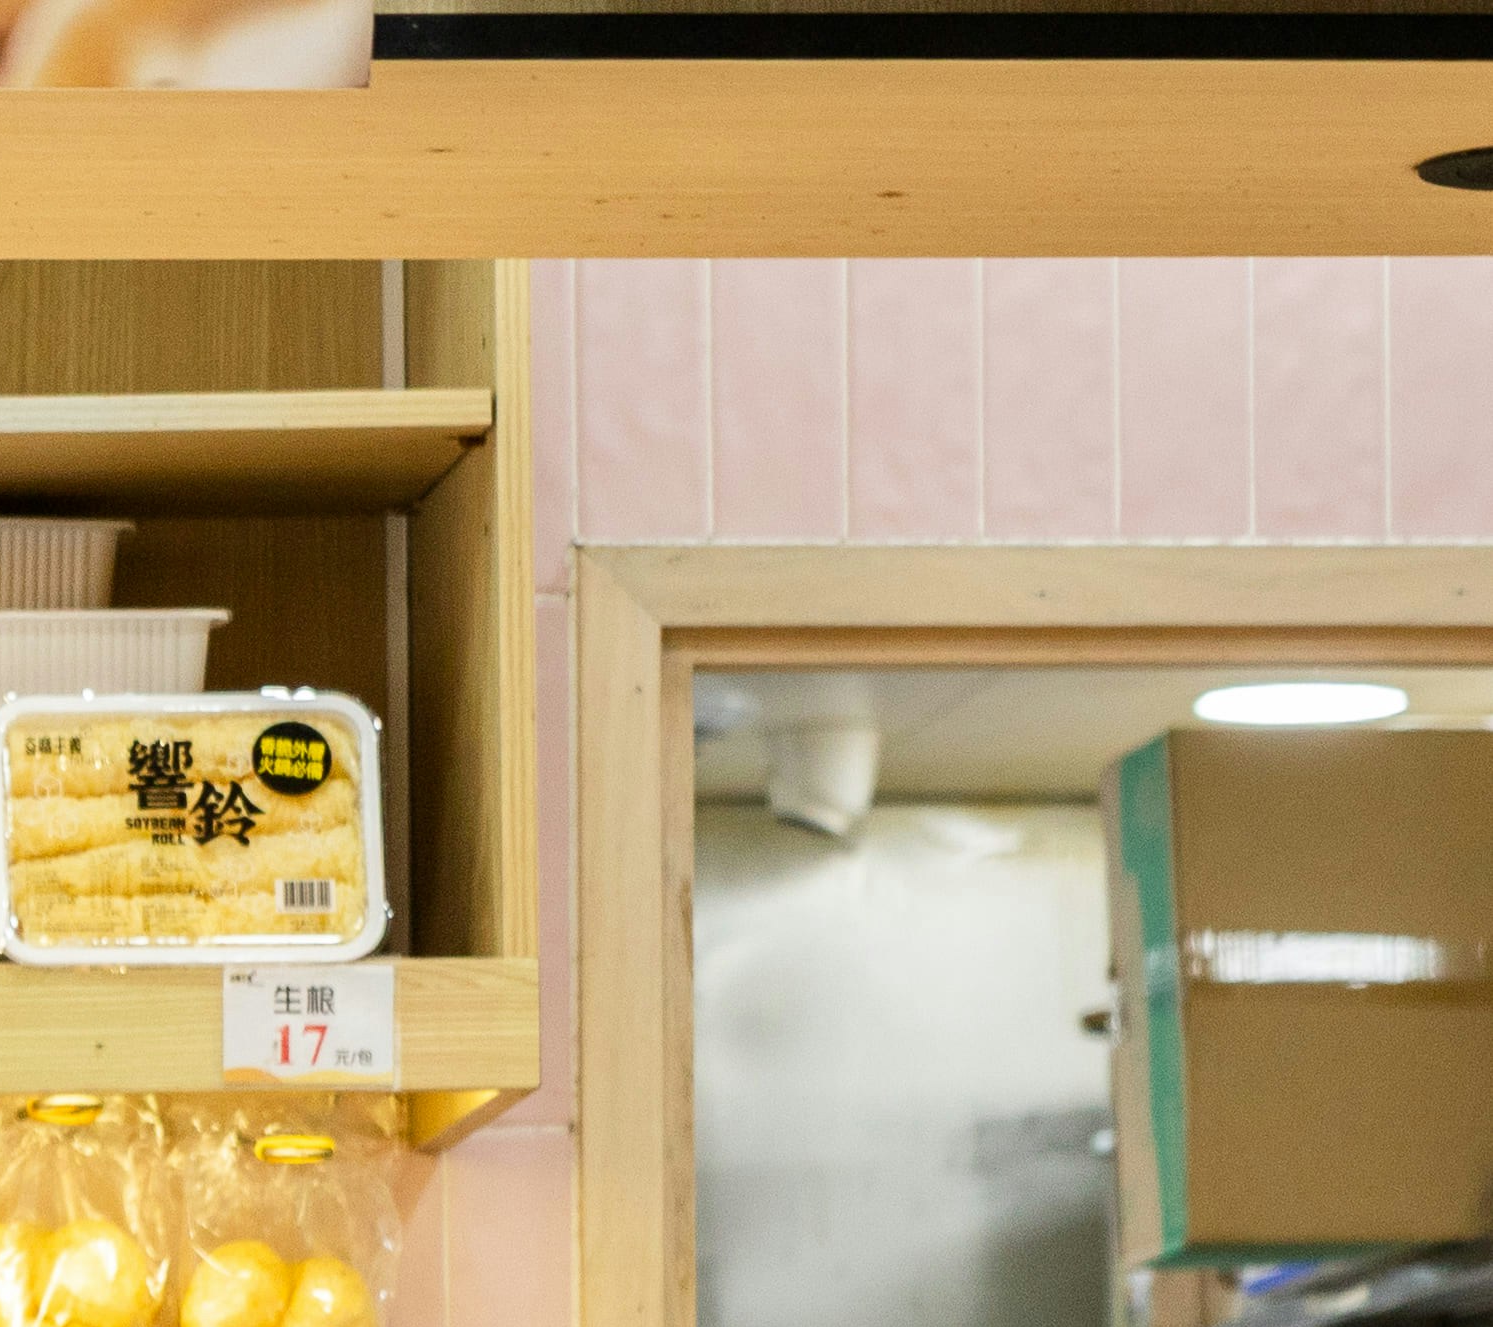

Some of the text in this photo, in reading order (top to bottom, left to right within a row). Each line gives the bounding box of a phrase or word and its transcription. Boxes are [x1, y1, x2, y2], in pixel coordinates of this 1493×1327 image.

[127, 739, 265, 847] 響鈴
[125, 817, 186, 831] SOYBEAN
[151, 833, 186, 846] ROLL
[274, 985, 336, 1015] 生根
[277, 1024, 328, 1066] 17
